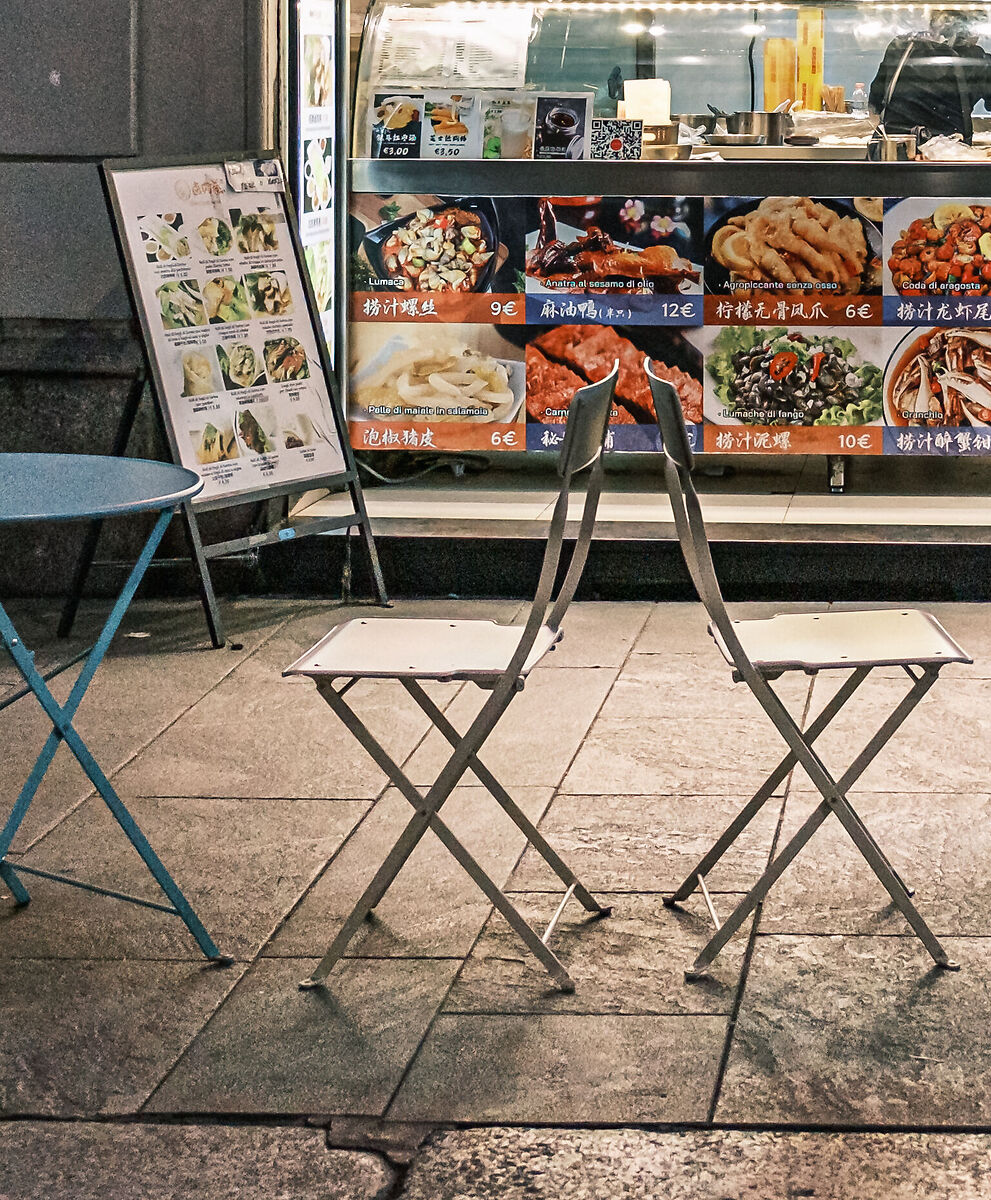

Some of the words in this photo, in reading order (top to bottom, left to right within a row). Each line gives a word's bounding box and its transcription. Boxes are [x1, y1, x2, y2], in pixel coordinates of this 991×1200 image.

[368, 277, 405, 287] Lumaca
[545, 280, 576, 288] Anatra
[627, 280, 635, 288] di
[723, 281, 785, 290] Agropiccante
[902, 281, 926, 290] Coda
[929, 282, 938, 290] di
[939, 282, 981, 291] aragosta
[490, 301, 518, 316] 9€
[661, 302, 696, 318] 12€
[715, 301, 829, 320] 柠檬无骨凤爪
[845, 303, 873, 319] 6€
[393, 406, 403, 414] di
[436, 407, 445, 415] in
[545, 407, 570, 416] Carn
[767, 410, 776, 418] di
[778, 410, 805, 420] fango
[362, 427, 437, 448] 泡椒猪皮
[491, 431, 519, 446] 6€
[715, 431, 793, 450] 捞汁泥螺
[838, 433, 873, 449] 10€
